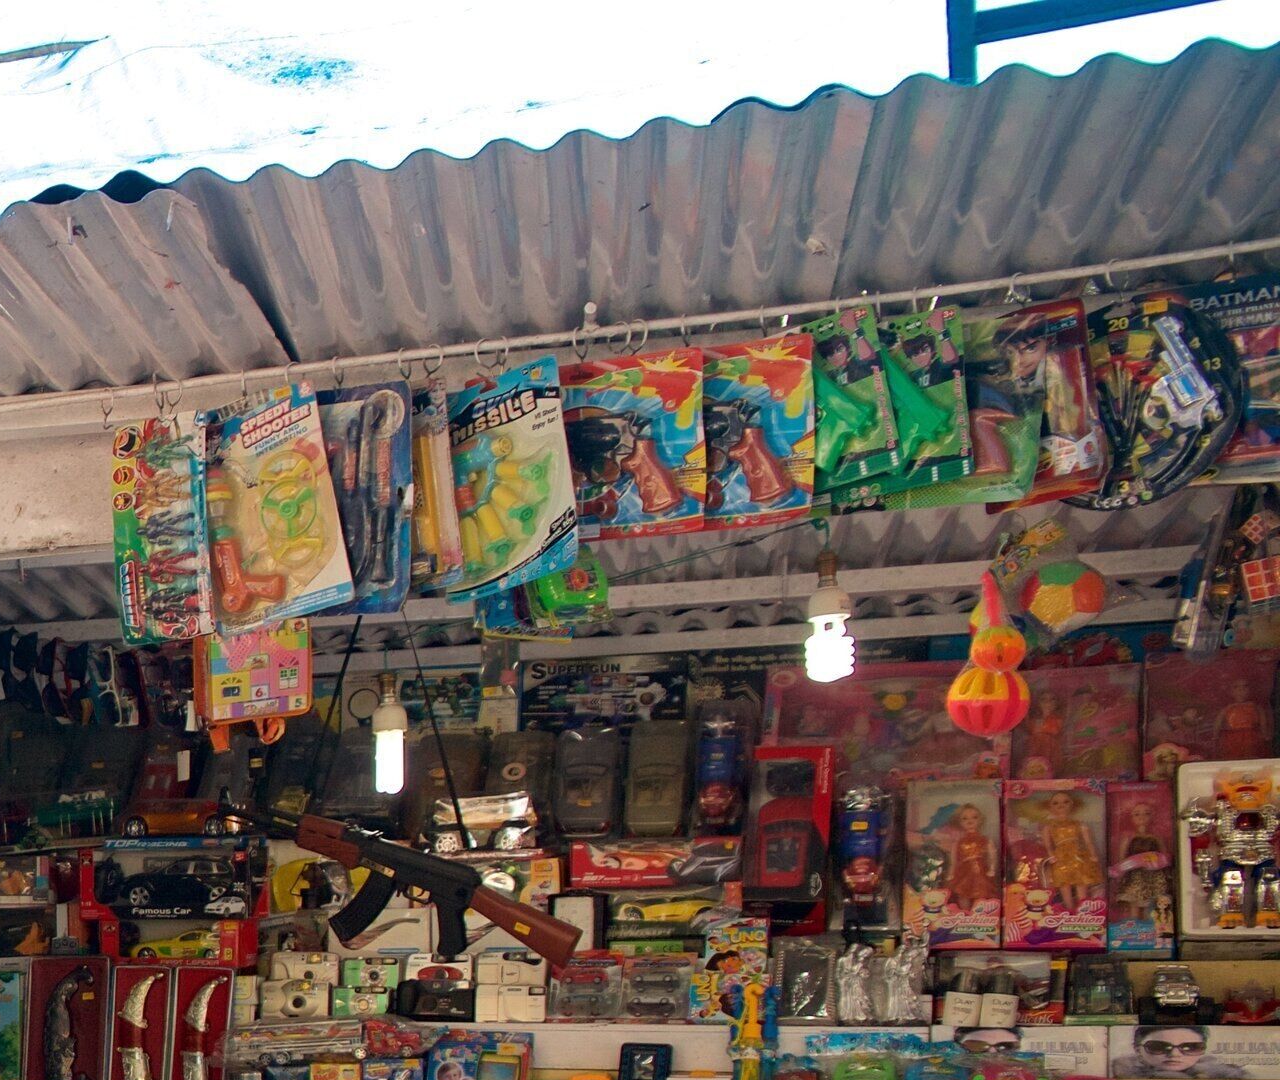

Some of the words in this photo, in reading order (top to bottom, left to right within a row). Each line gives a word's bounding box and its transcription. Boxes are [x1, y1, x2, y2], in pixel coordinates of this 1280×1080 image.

[1109, 317, 1129, 331] 20
[1190, 336, 1201, 349] 4
[1203, 357, 1222, 370] 13
[240, 398, 291, 436] SPEEDY
[451, 389, 537, 446] MISSILE
[242, 403, 311, 449] SHOOTER
[254, 432, 281, 451] FUNNY
[283, 423, 300, 435] AND
[1119, 481, 1130, 493] 3
[132, 907, 171, 915] Famous
[173, 907, 192, 915] Car
[942, 910, 1001, 927] Fashion
[1044, 910, 1106, 927] Fashion
